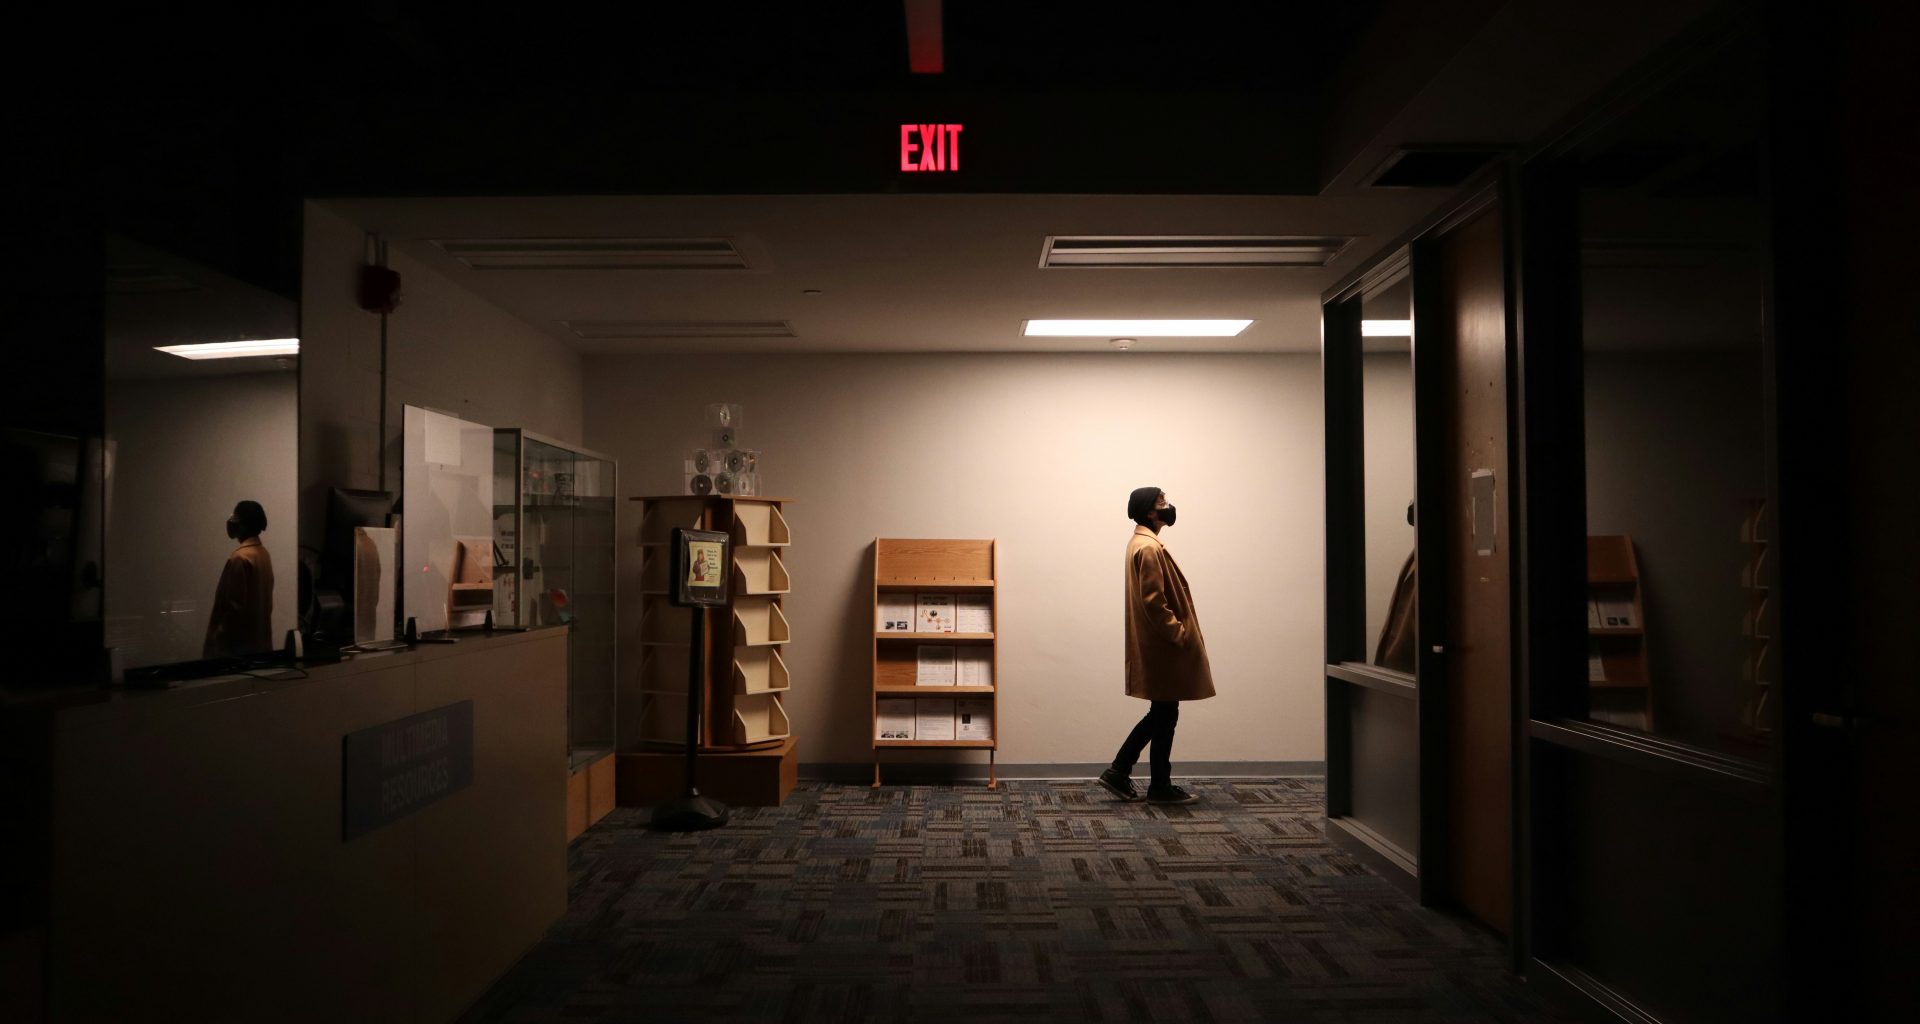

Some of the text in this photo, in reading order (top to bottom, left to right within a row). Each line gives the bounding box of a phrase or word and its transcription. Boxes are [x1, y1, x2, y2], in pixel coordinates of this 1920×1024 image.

[900, 123, 964, 172] EXIT
[381, 715, 449, 769] MULTIMEDIA
[381, 757, 449, 817] RESOURCES
